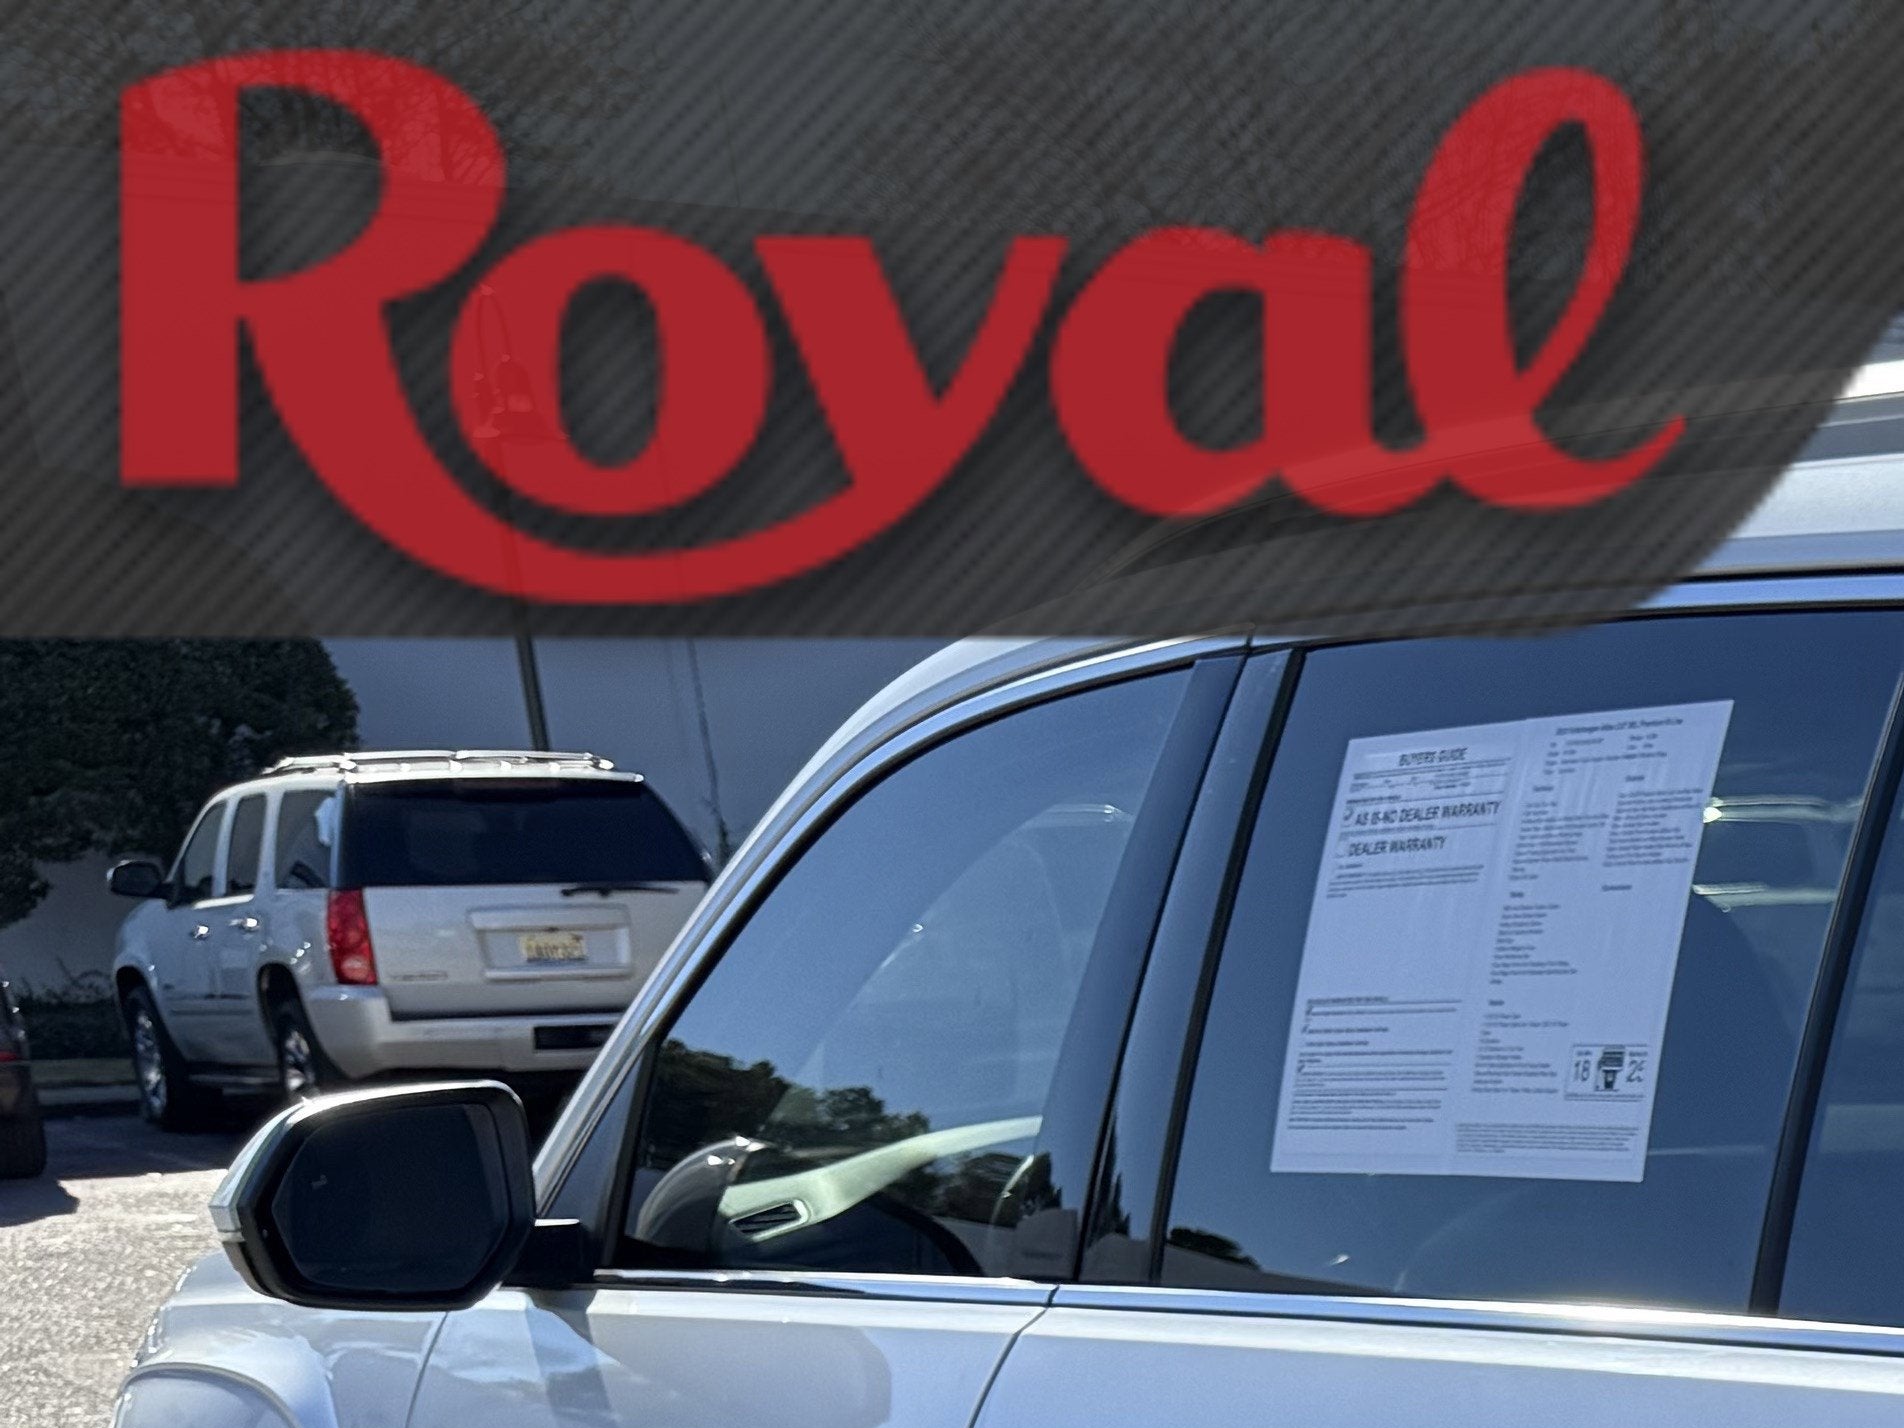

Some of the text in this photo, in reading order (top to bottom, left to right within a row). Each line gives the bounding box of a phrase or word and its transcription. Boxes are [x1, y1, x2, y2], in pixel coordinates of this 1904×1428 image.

[1399, 805, 1441, 823] DEALER
[1442, 800, 1503, 818] WARRANTY
[1347, 835, 1448, 858] DEALER WARRANTY
